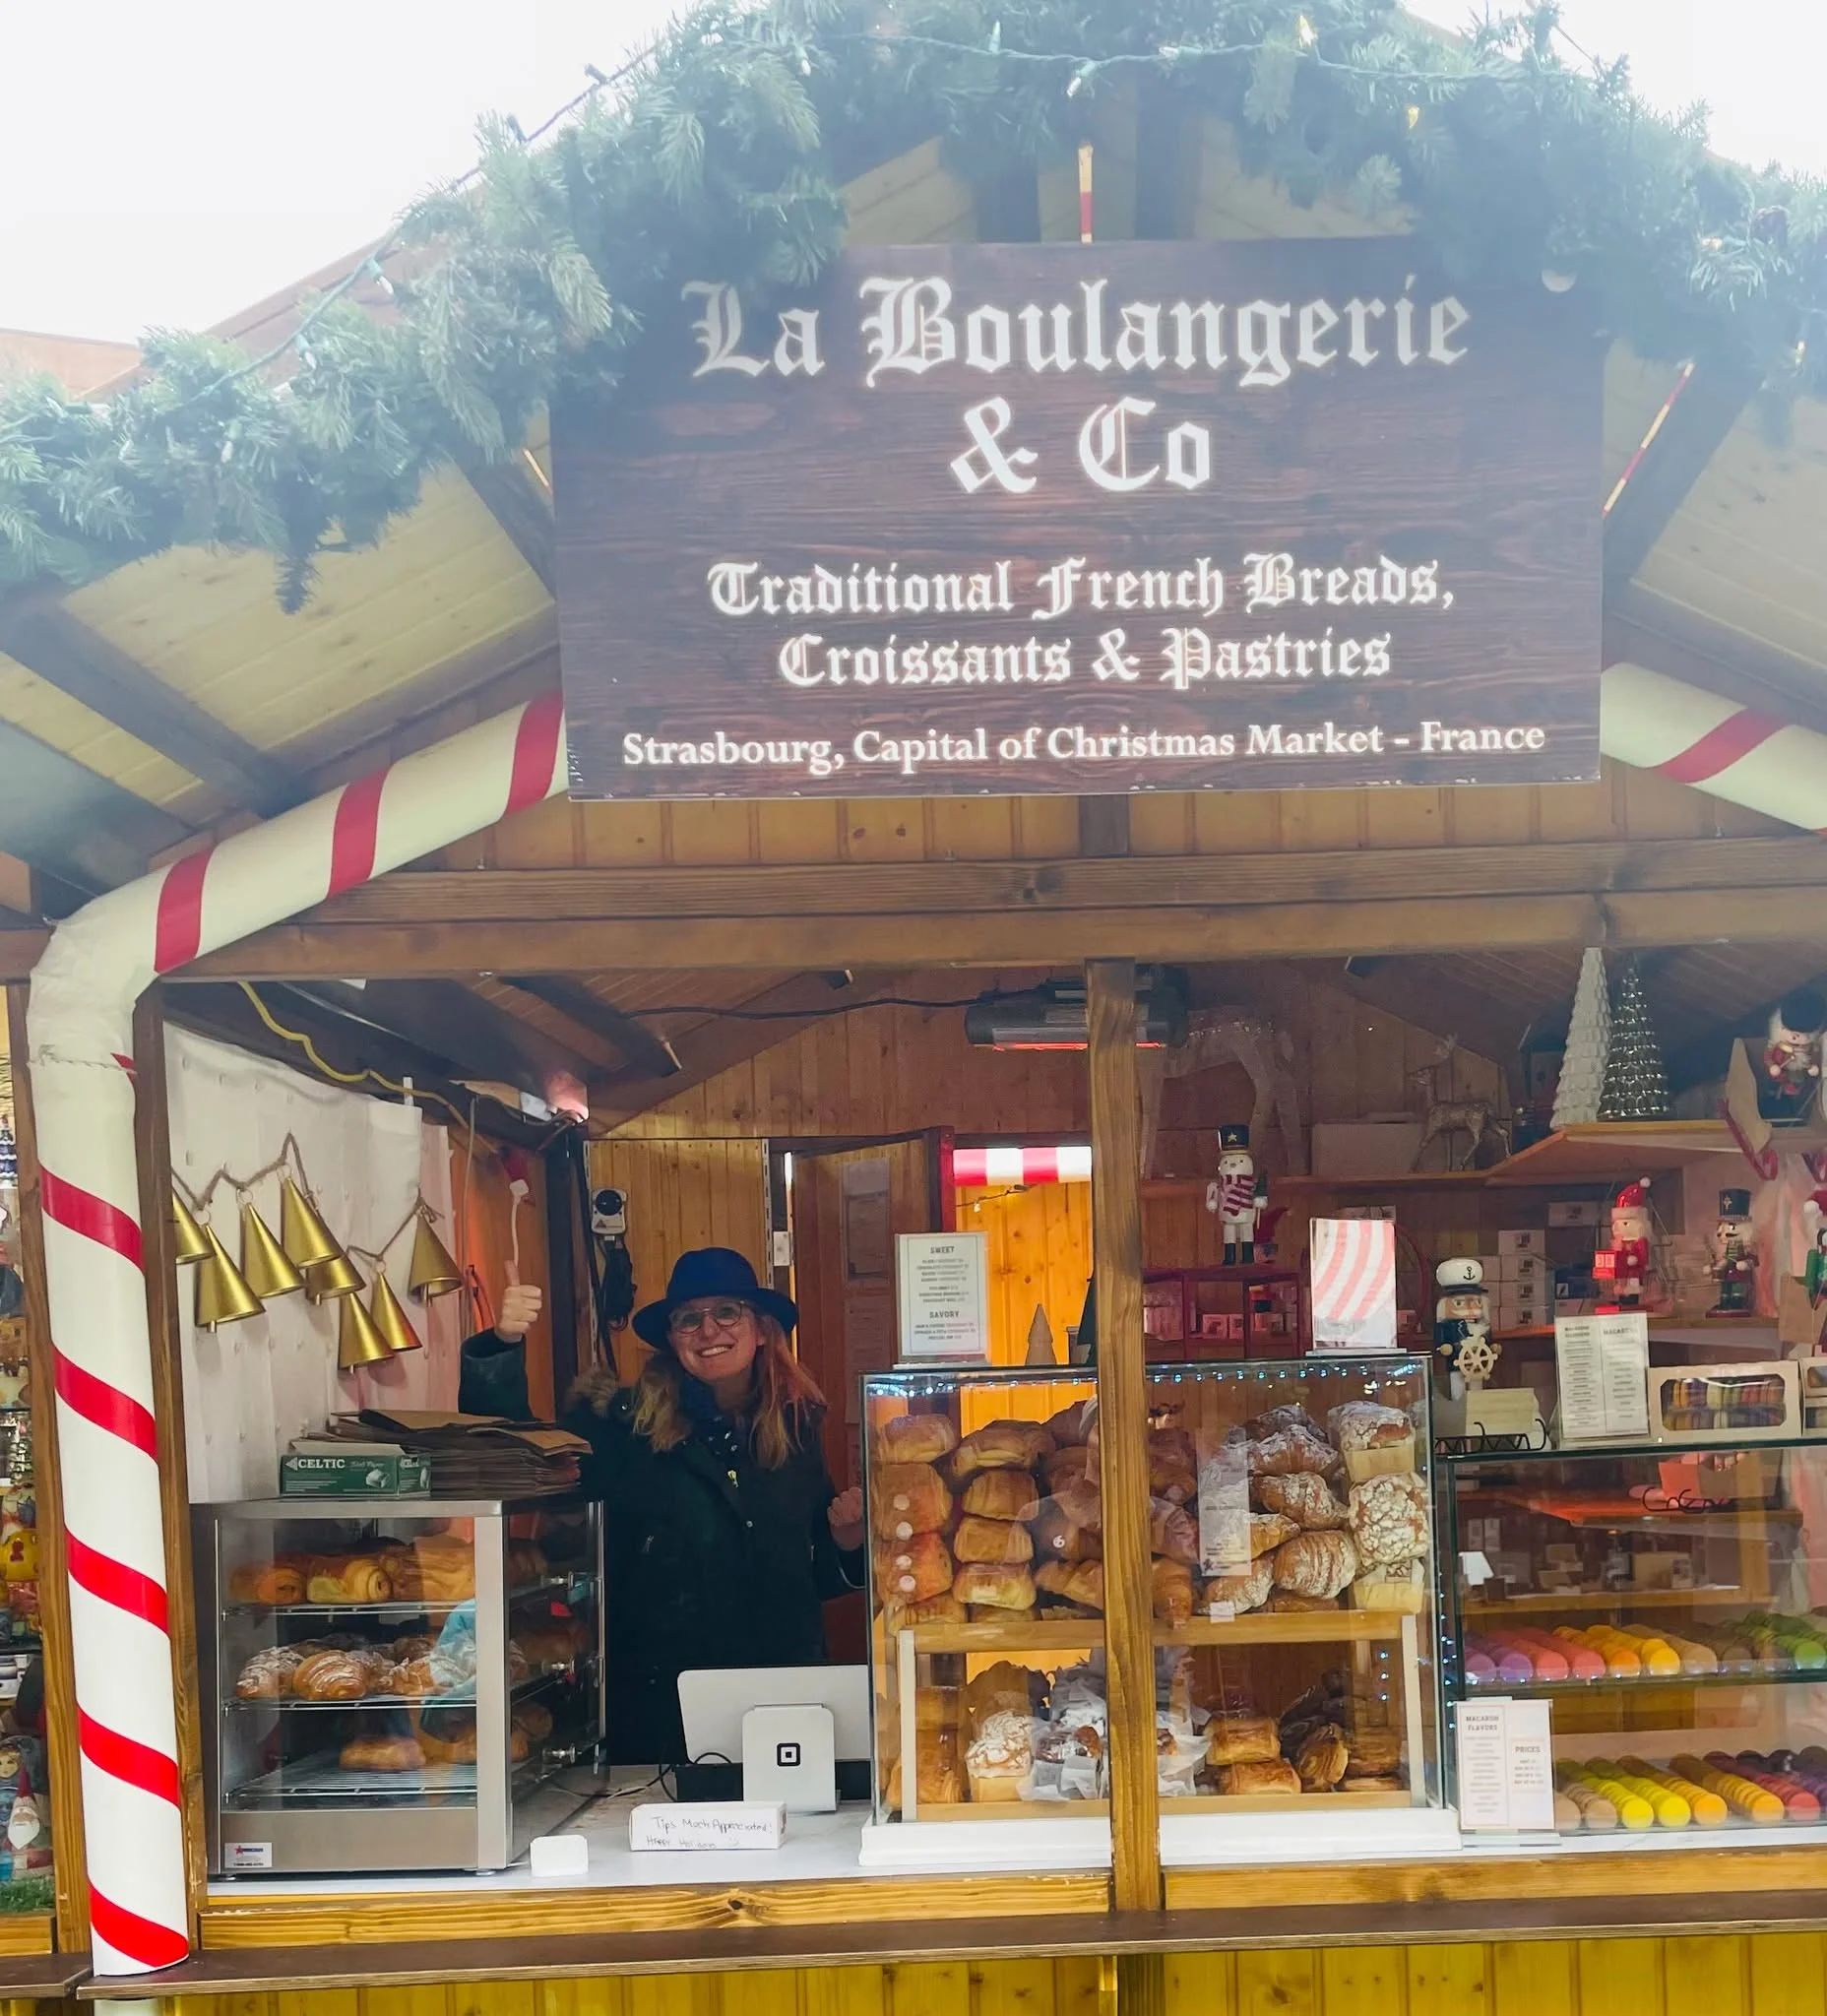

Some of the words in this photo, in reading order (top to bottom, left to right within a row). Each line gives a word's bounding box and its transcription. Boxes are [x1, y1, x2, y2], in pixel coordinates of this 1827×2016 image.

[681, 281, 825, 377] La
[858, 276, 1470, 389] Boulangerie
[949, 396, 1039, 494] &
[1078, 396, 1215, 492] Co
[707, 559, 1015, 616] Traditional
[1031, 556, 1224, 620] French
[1243, 552, 1454, 614] Breads,
[779, 633, 1072, 687] Croissants
[1091, 627, 1141, 681] &
[1159, 626, 1392, 691] Pastries
[623, 730, 846, 777] Strasbourg,
[852, 727, 989, 775] Capital
[998, 726, 1042, 760] of
[1047, 724, 1235, 759] Christmas
[1245, 721, 1385, 755] Market
[1419, 721, 1545, 752] France
[930, 1245, 955, 1254] SWEET
[298, 1459, 346, 1468] CELTIC
[654, 1817, 676, 1834] Tips
